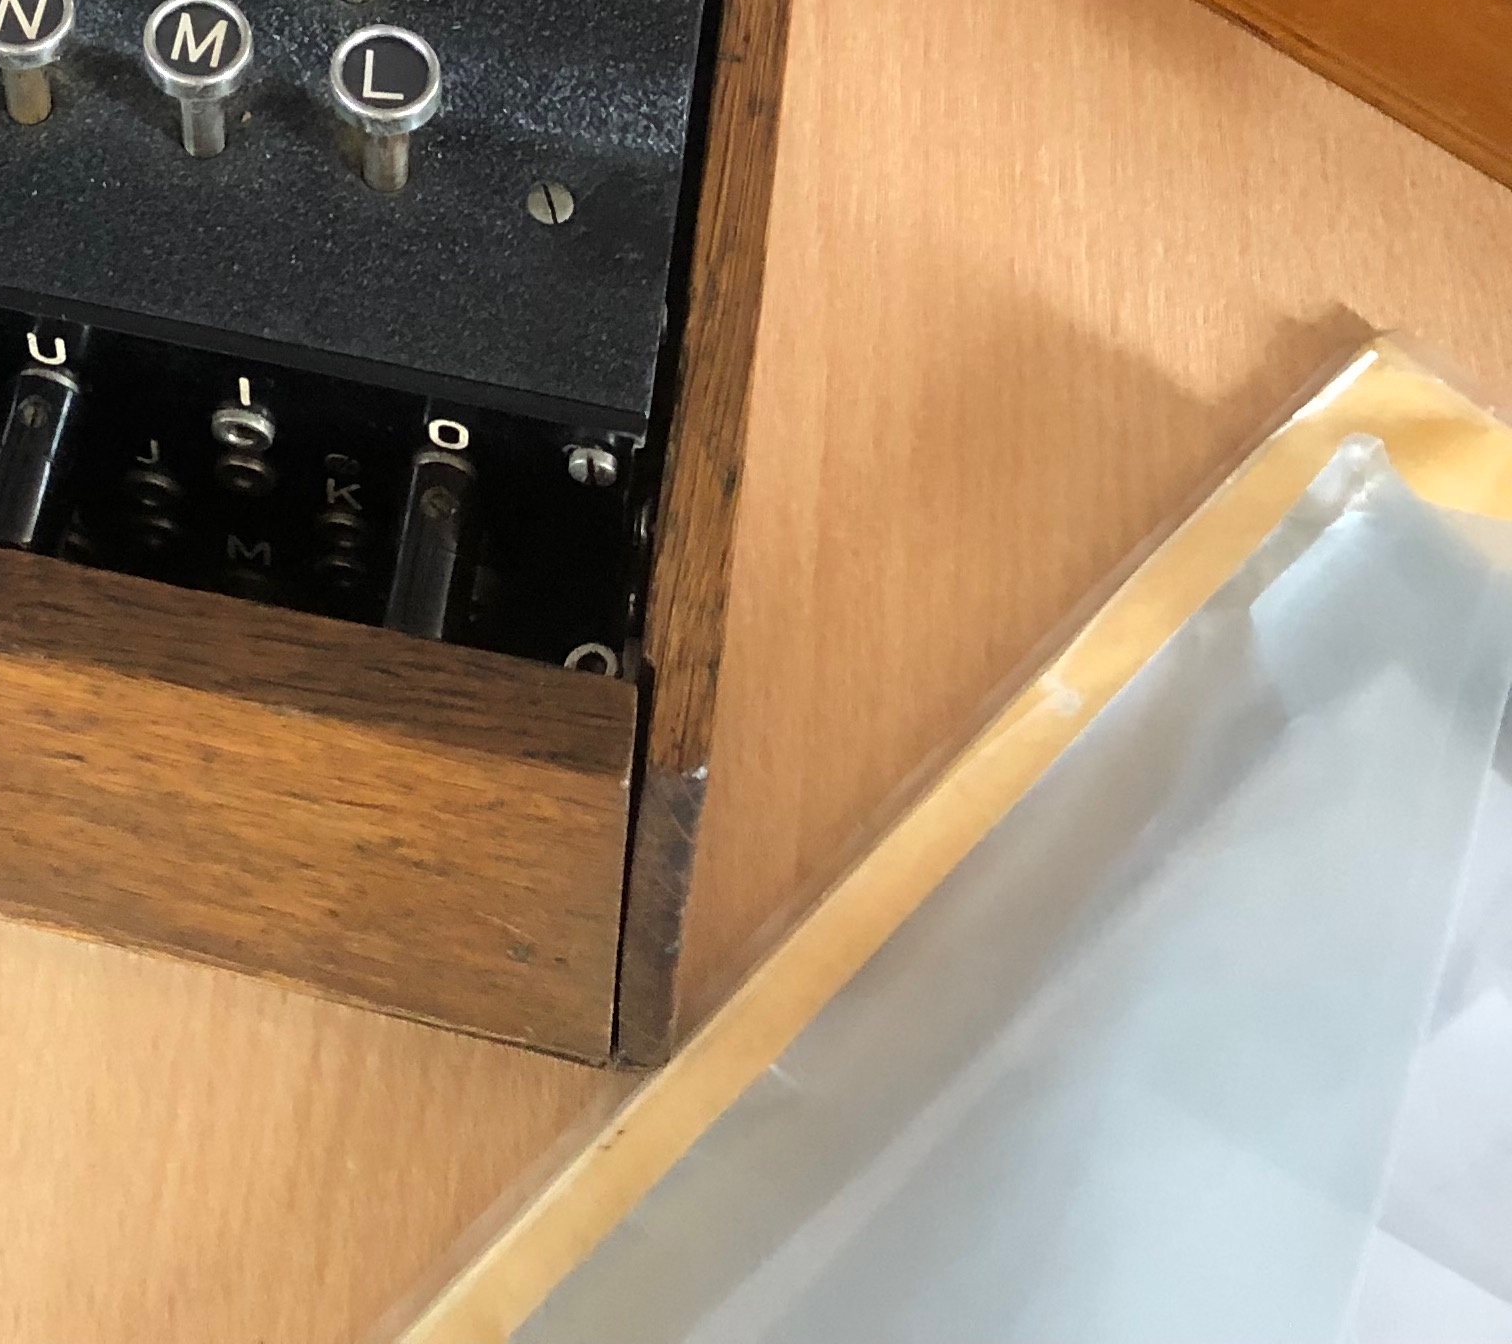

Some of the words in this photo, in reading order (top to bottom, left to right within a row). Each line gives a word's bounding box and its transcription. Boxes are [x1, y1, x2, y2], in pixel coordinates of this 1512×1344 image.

[170, 12, 229, 68] M
[362, 49, 404, 101] L
[26, 332, 67, 365] U
[238, 376, 251, 406] I
[428, 419, 469, 450] O
